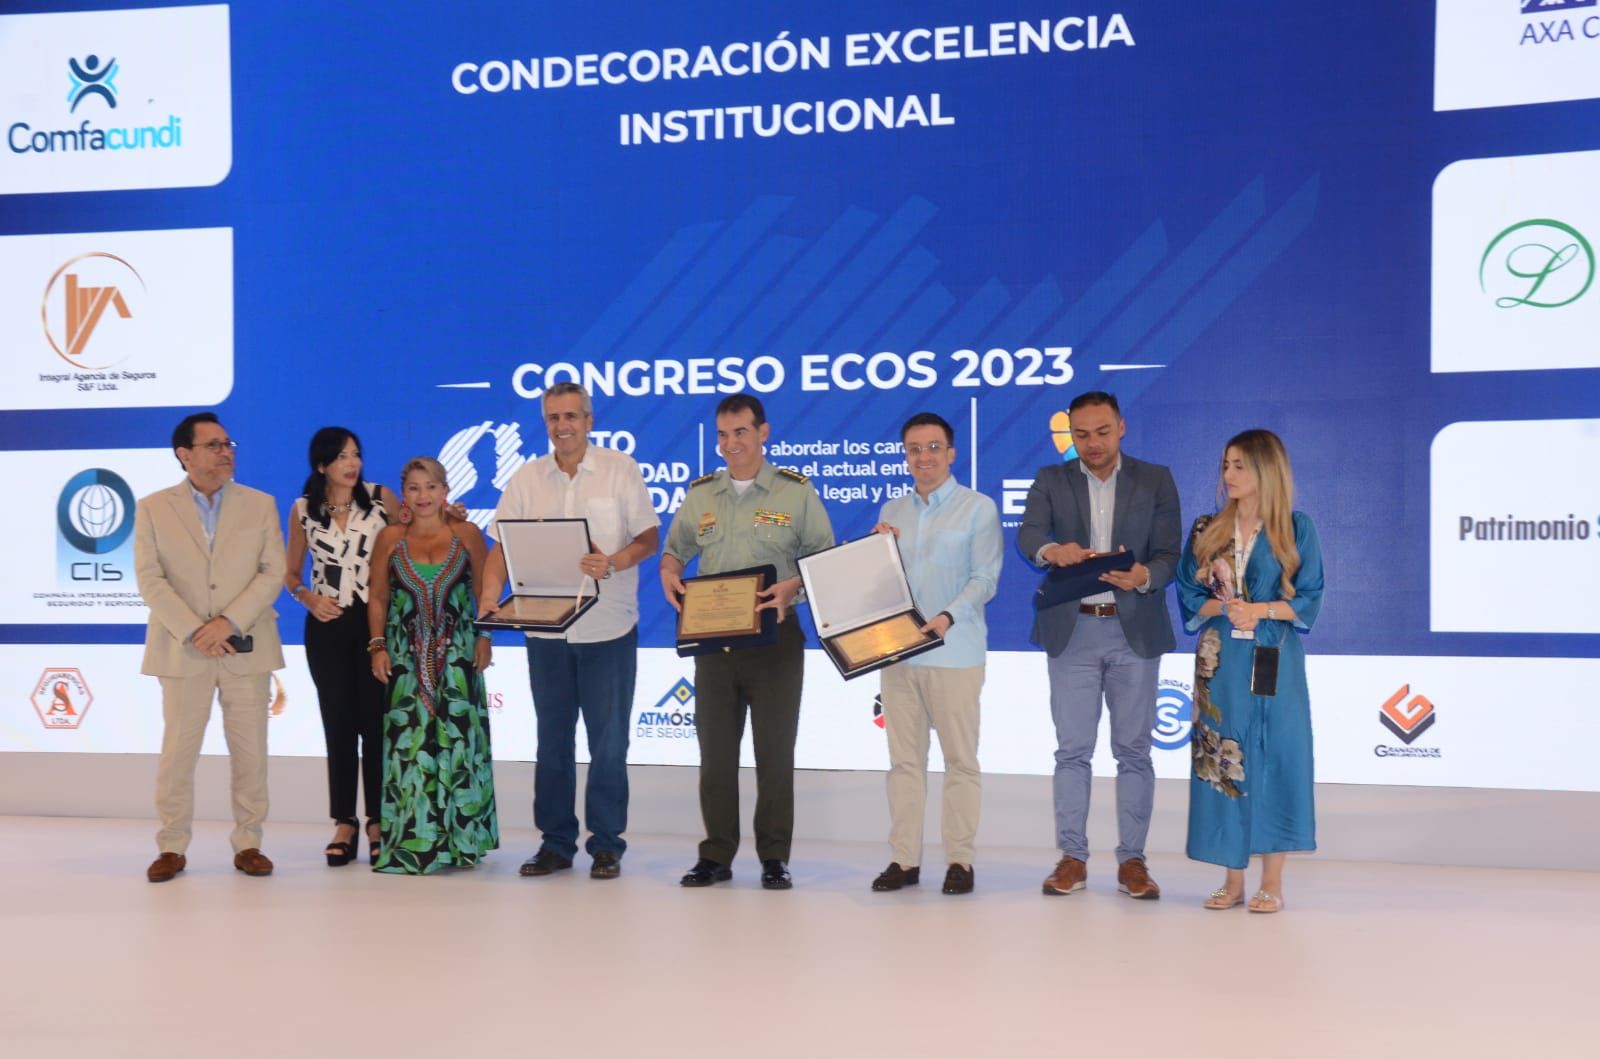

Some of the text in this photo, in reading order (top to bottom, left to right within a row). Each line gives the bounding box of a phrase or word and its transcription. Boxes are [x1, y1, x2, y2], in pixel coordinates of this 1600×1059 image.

[1519, 16, 1600, 46] AXA C
[453, 13, 1135, 94] CONDECORACIÓN EXCELENCIA
[620, 93, 955, 145] INSTITUCIONAL
[8, 115, 181, 154] Comfacundi
[512, 347, 1074, 399] CONGRESO ECOS 2023
[770, 440, 840, 456] abordar
[844, 440, 870, 455] los
[873, 441, 905, 455] car
[802, 461, 819, 478] el
[822, 460, 877, 477] actual
[881, 460, 909, 476] ent
[823, 484, 868, 504] legal
[872, 487, 883, 503] y
[887, 483, 914, 501] lab
[1459, 513, 1590, 541] Patrimonio
[71, 562, 123, 581] CIS
[638, 708, 697, 726] ATMÓS
[636, 727, 653, 738] DE
